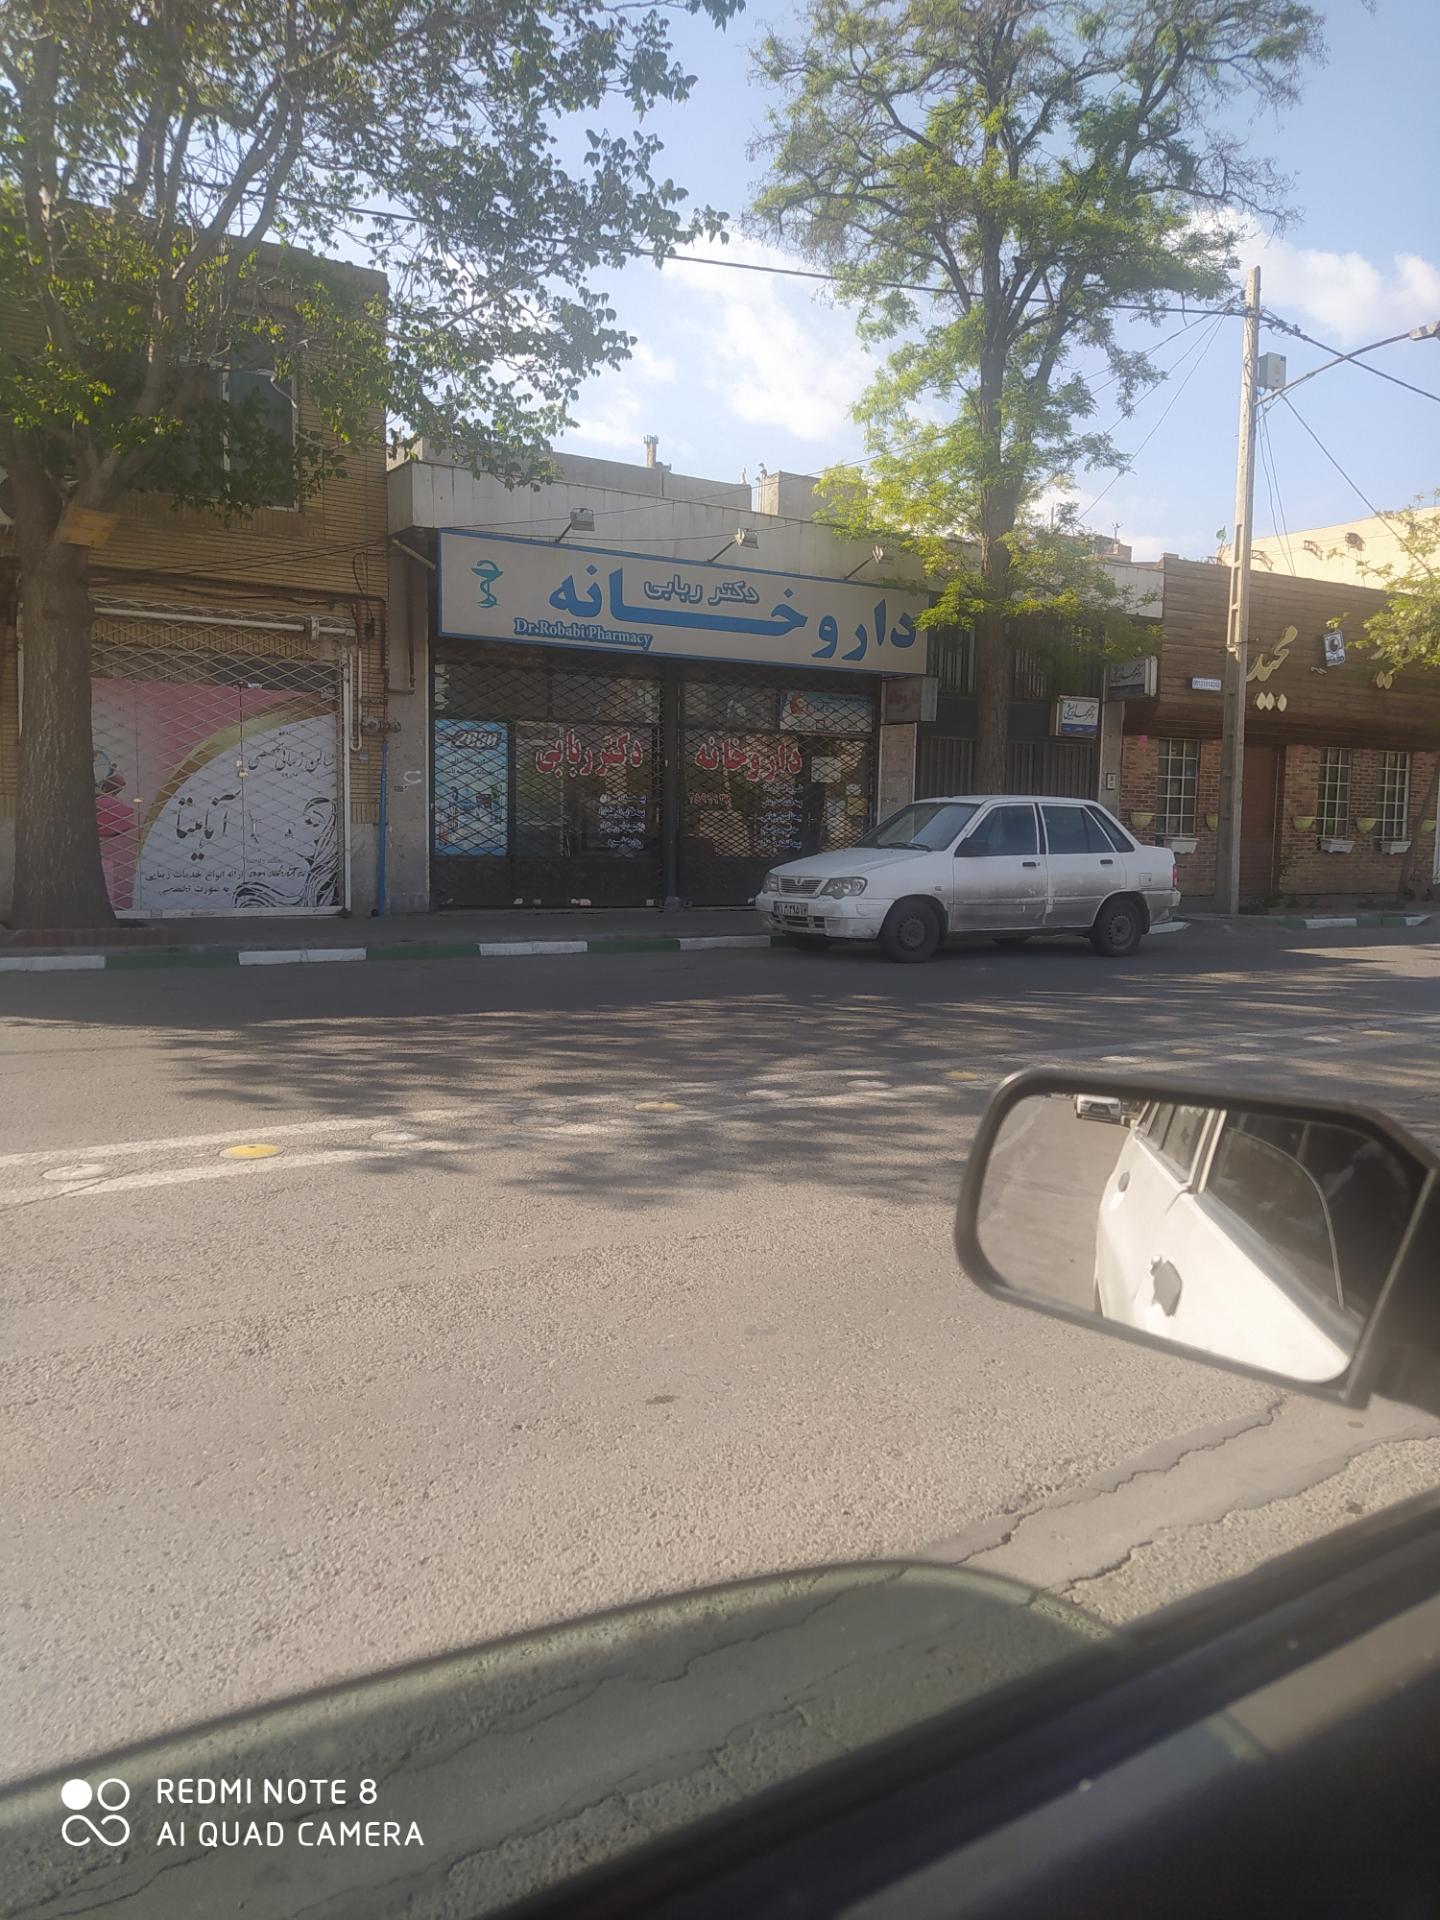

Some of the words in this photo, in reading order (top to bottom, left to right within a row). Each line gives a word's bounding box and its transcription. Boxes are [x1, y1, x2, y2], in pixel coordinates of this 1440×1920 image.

[644, 575, 702, 602] ربابی
[709, 581, 760, 605] دکتر
[514, 618, 586, 639] Dr.Robabi
[589, 628, 653, 650] Pharmacy
[549, 562, 917, 661] داروخانه
[535, 728, 593, 778] ربابی
[595, 732, 643, 777] دکتر
[694, 736, 803, 783] داروخانه
